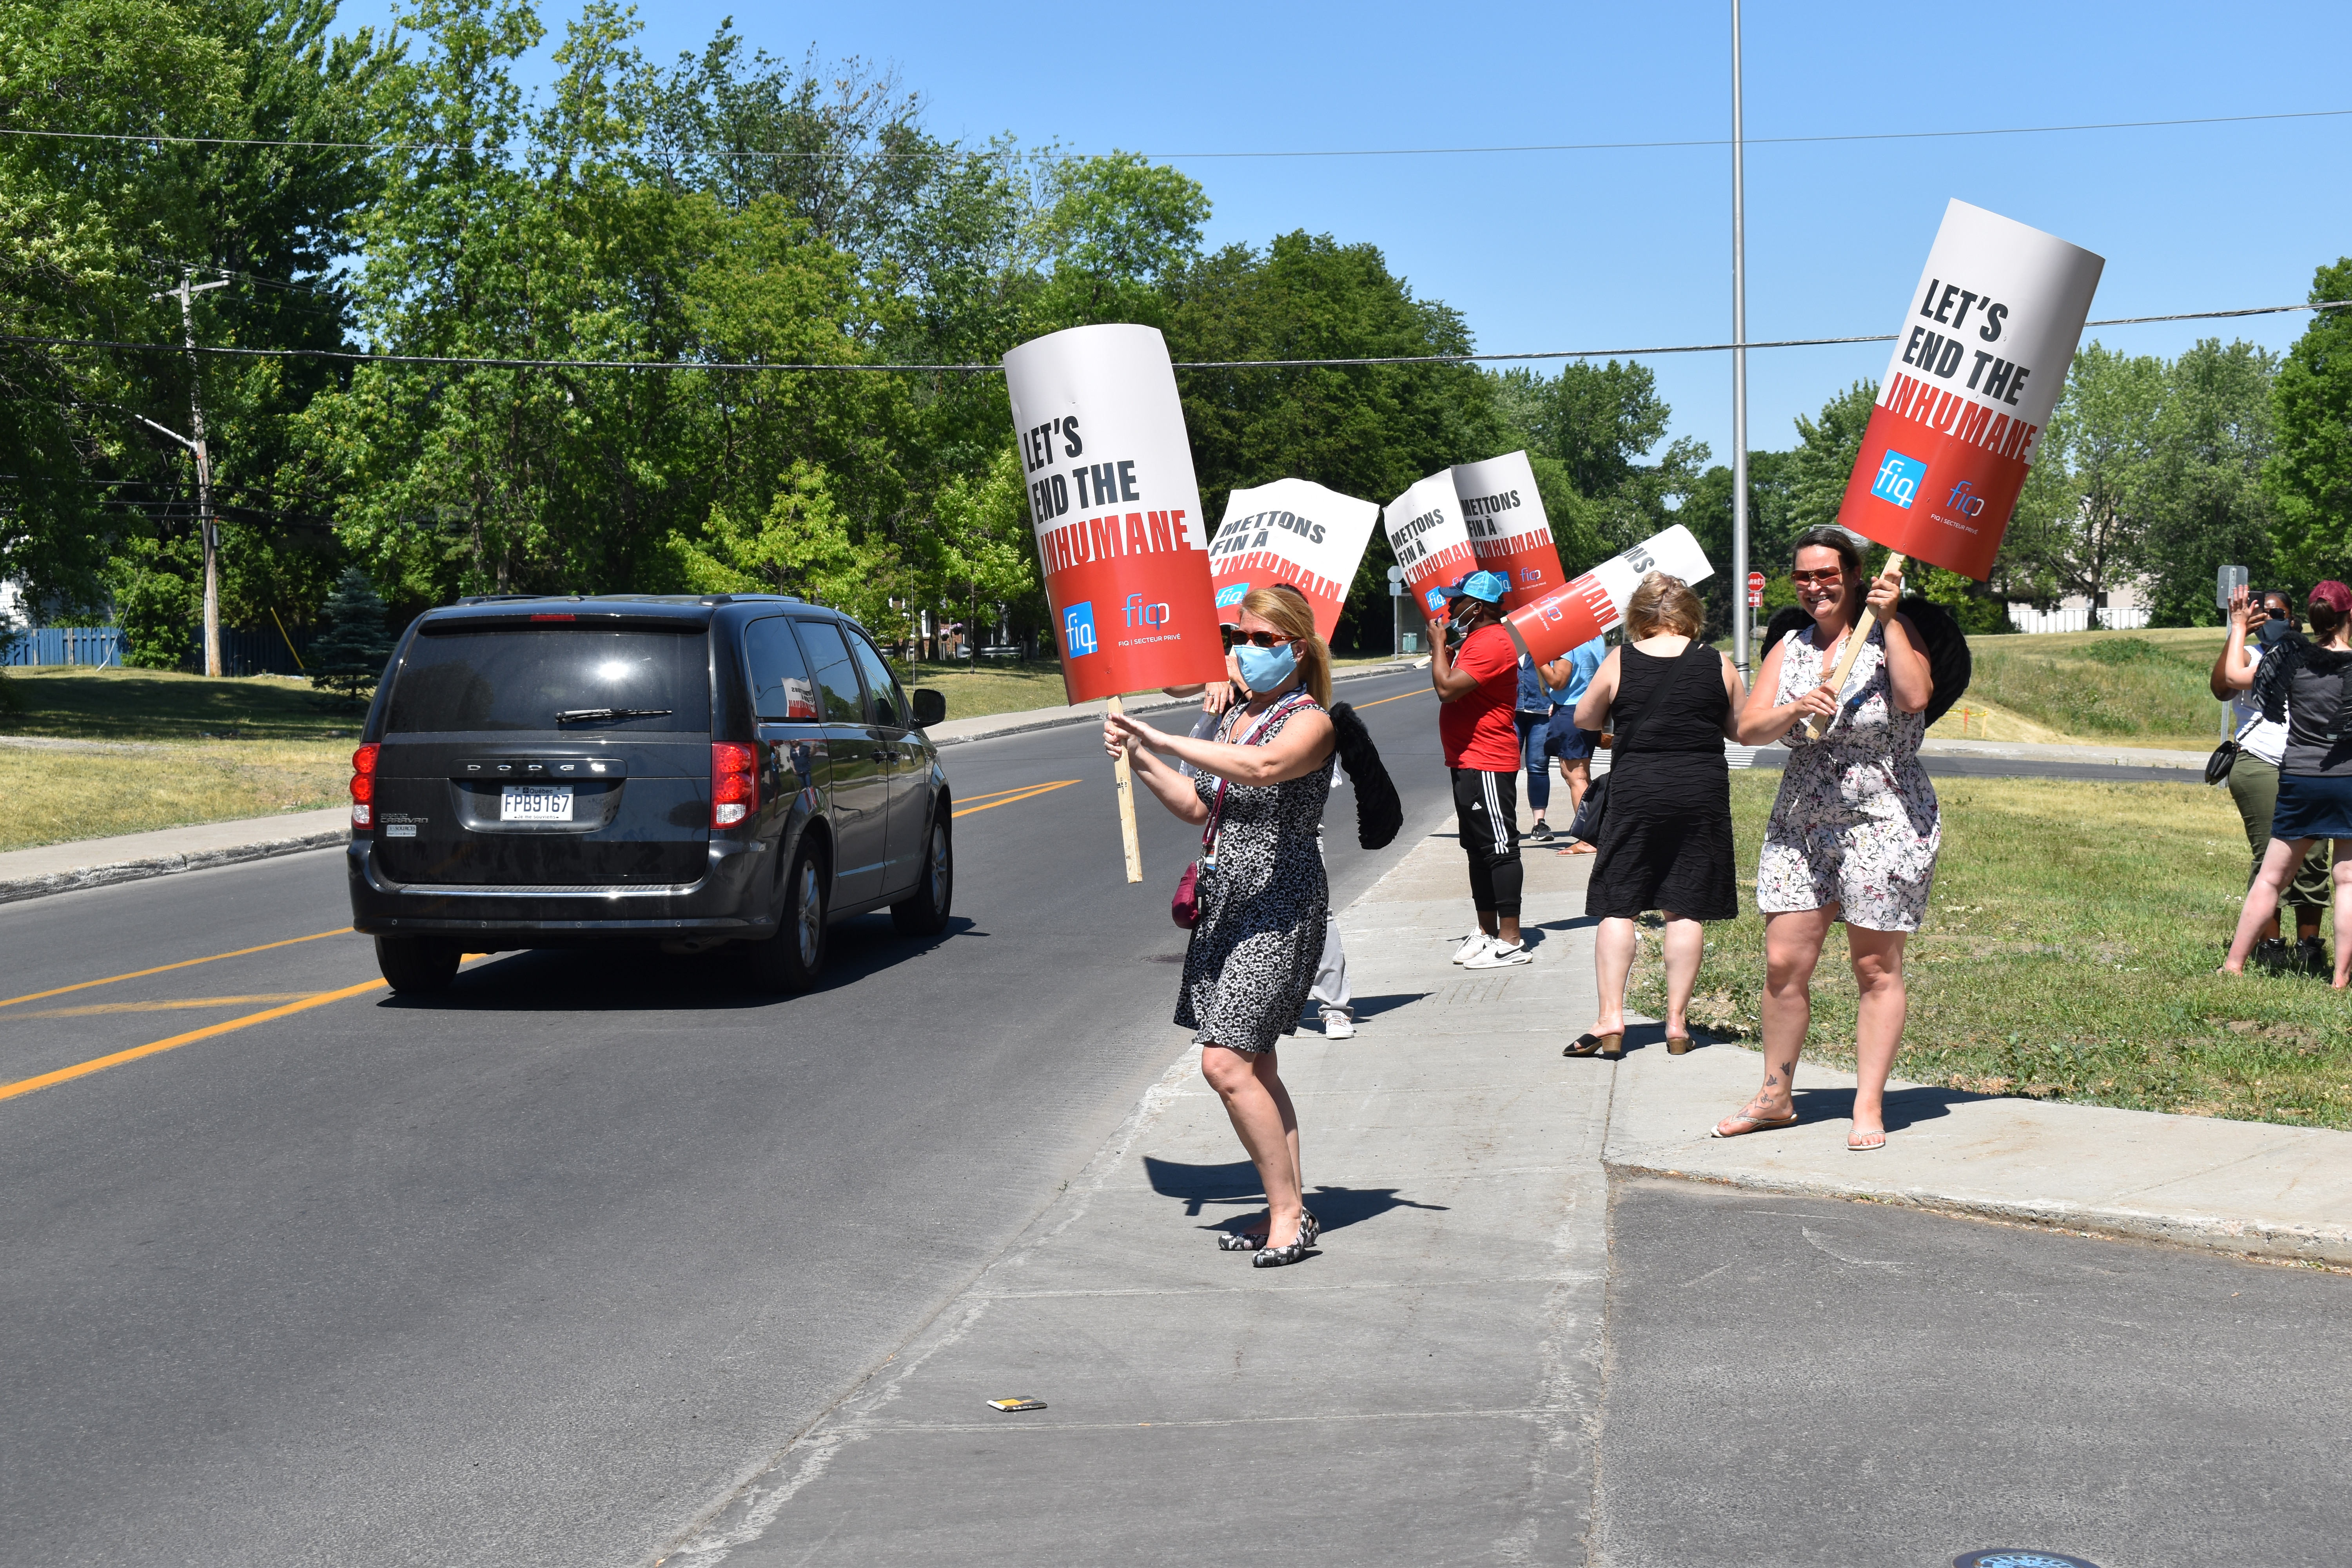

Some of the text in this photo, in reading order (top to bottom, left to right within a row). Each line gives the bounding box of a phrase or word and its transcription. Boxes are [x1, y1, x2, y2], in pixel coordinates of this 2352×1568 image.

[1920, 278, 2008, 343] LET'S
[1902, 325, 2031, 406] END THE
[1884, 372, 2038, 464] INHUMANE
[1024, 416, 1083, 473] LET'S
[1032, 460, 1140, 524] END THE
[1877, 459, 1913, 507] fiq
[1460, 490, 1521, 516] METTONS
[1040, 510, 1191, 577] INHUMANE
[1209, 528, 1269, 557] FIN À
[1219, 510, 1326, 544] METTONS
[1391, 509, 1445, 550] METTONS
[1466, 515, 1497, 537] FIN À
[1472, 527, 1550, 558] L'INHUMAIN
[1943, 519, 1965, 530] SECTEUR
[1965, 526, 1978, 535] PRIVÉ
[1397, 538, 1427, 568] FIN À
[1065, 612, 1097, 654] fiq
[1134, 636, 1163, 644] SECTEUR
[505, 794, 569, 812] FPB9167
